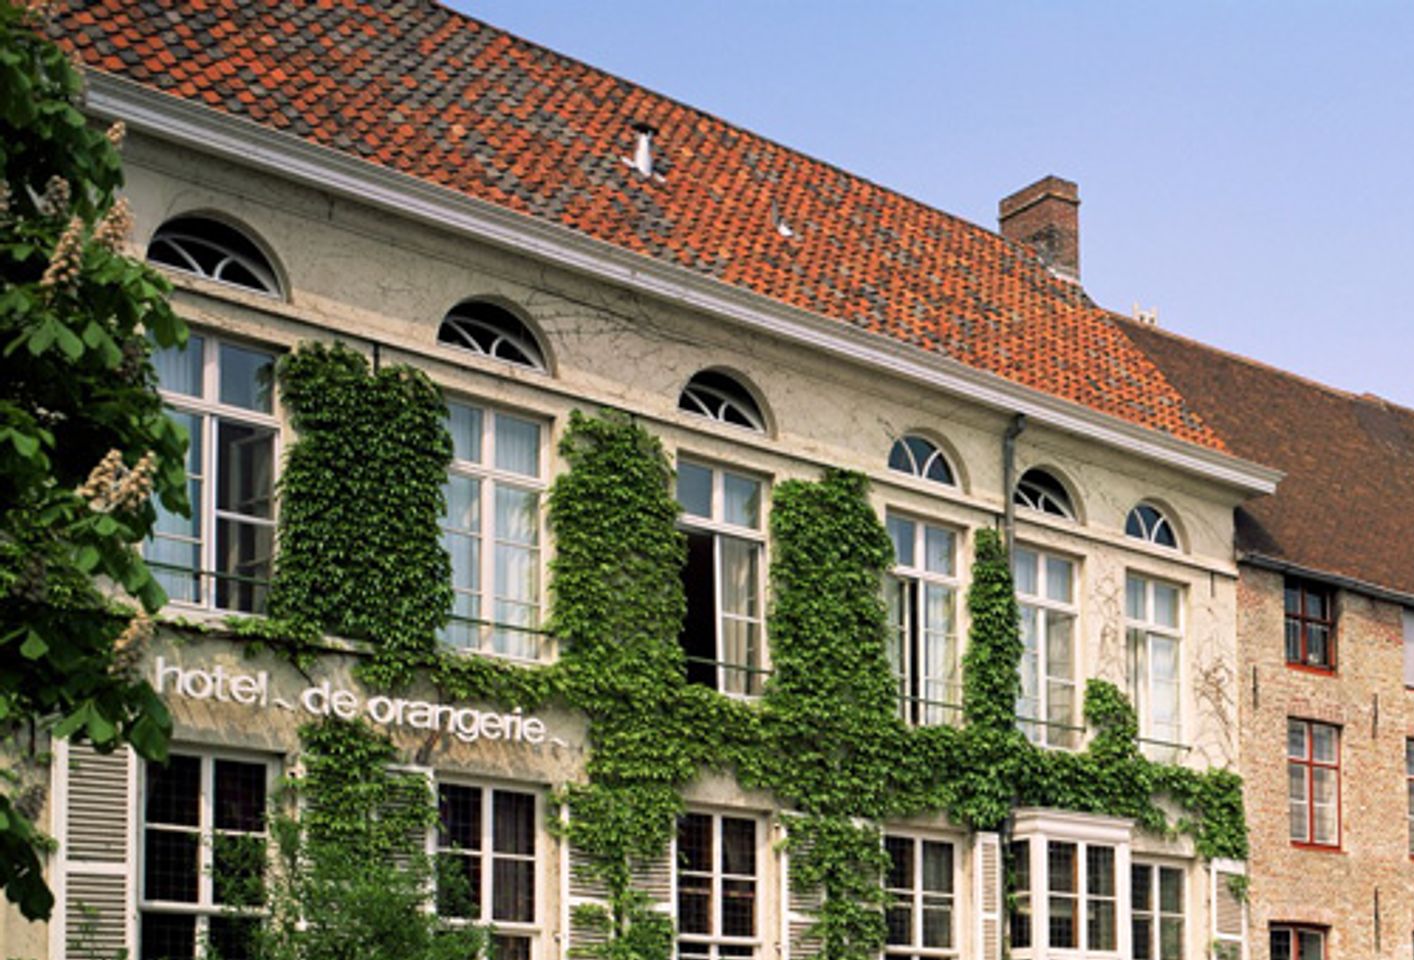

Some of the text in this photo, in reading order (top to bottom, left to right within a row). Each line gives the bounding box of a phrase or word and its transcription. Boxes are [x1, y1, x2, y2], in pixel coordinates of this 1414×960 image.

[154, 655, 546, 743] hotel de orangerie
